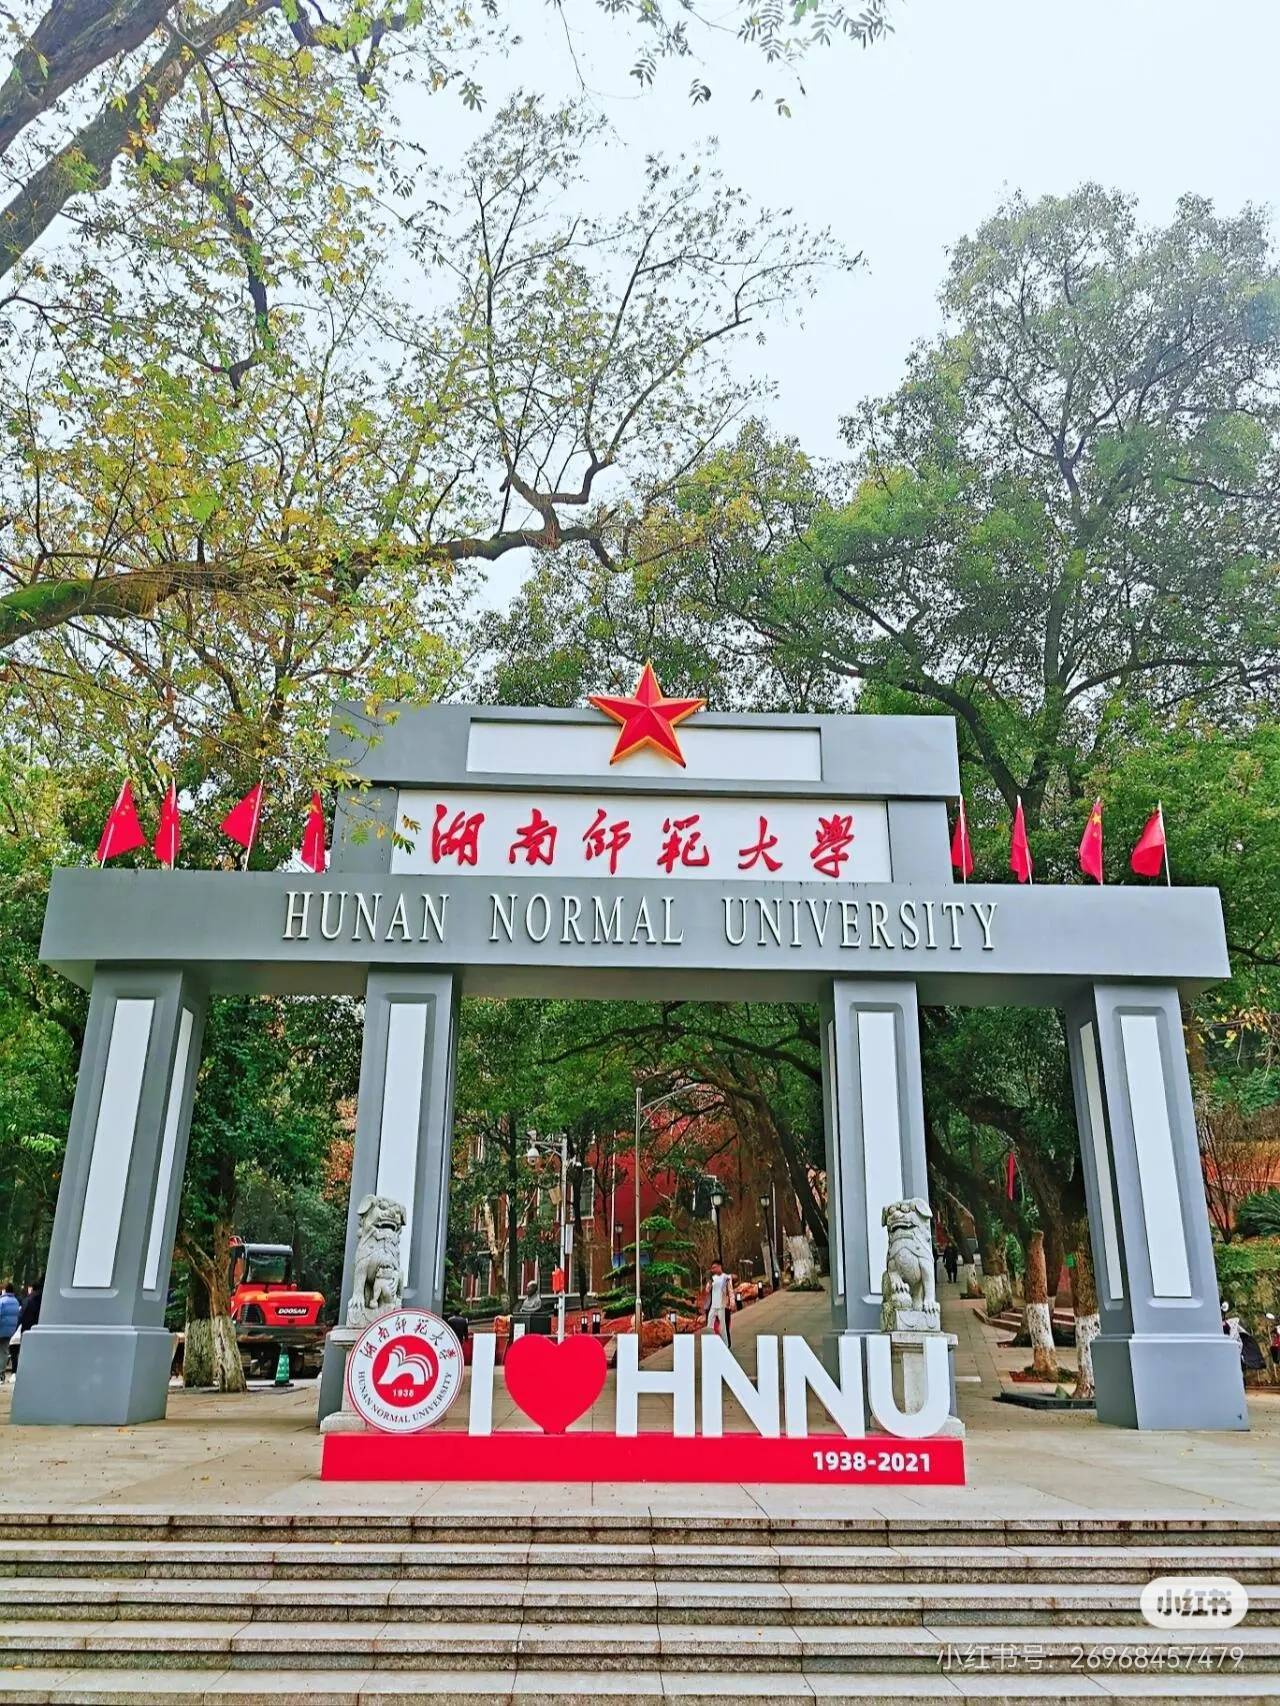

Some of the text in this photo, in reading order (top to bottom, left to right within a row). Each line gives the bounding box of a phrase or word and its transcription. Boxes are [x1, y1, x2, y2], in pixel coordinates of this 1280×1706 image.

[282, 891, 998, 950] HUNAN NORMAL UNIVERSITY
[278, 1307, 307, 1315] DOOSAN
[358, 1370, 452, 1423] HUNAN NORMAL UNIVERSITY
[393, 1389, 414, 1398] 1938
[468, 1333, 950, 1439] I HNNU
[813, 1451, 930, 1472] 1938-2021
